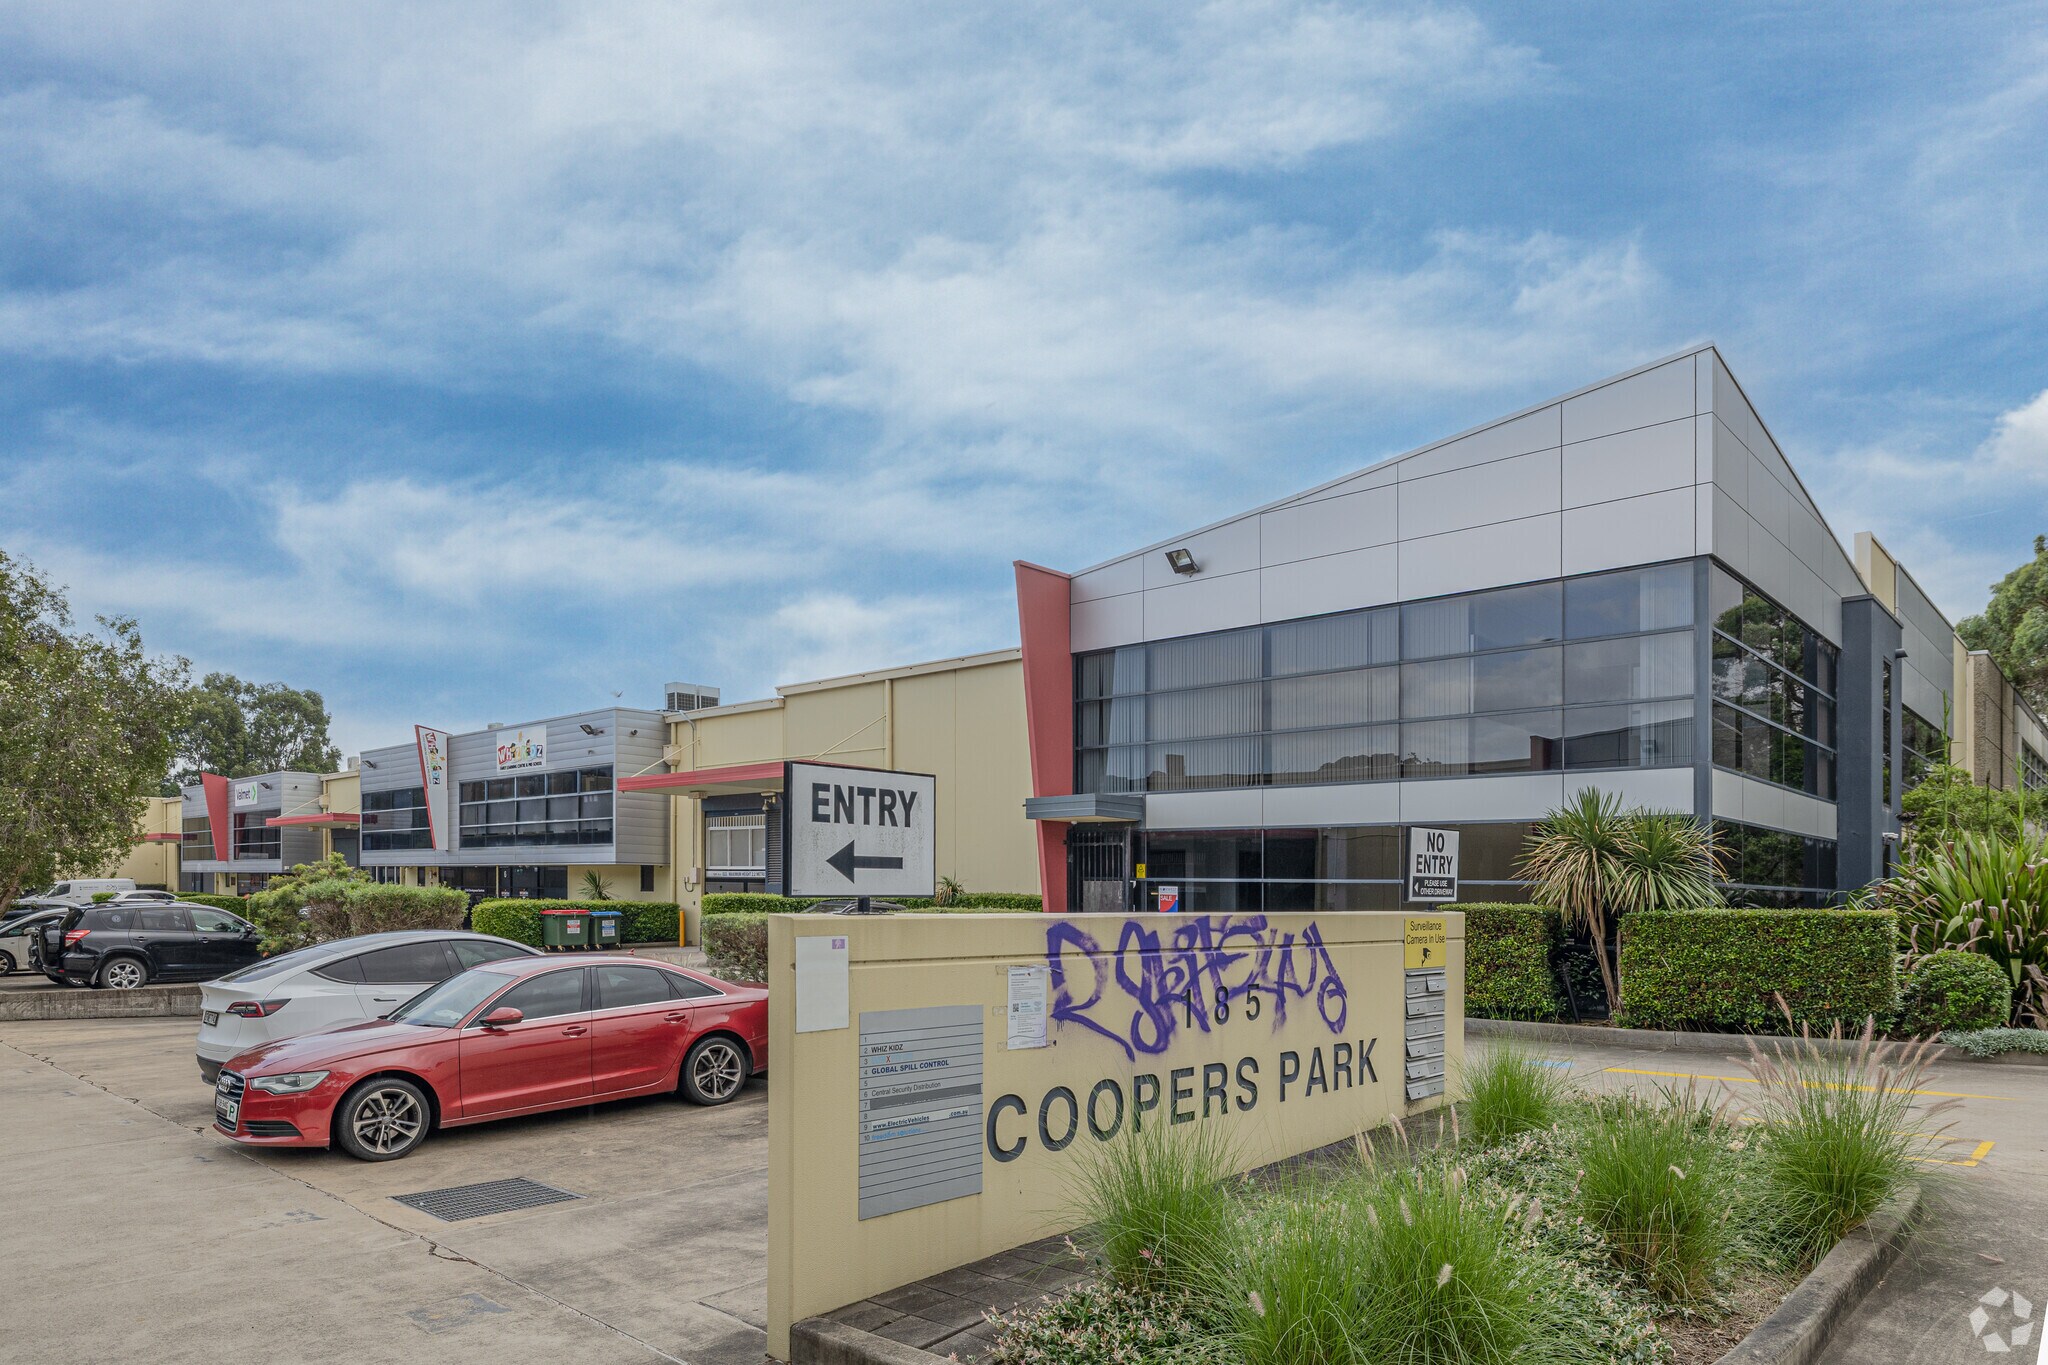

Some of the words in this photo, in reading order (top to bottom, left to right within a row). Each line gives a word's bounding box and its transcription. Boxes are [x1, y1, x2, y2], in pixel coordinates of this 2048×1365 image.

[812, 782, 918, 828] ENTRY
[1426, 831, 1445, 853] NO
[1416, 853, 1453, 875] ENTRY
[1424, 879, 1440, 887] PLEASE
[1440, 879, 1448, 887] USE
[1420, 887, 1434, 895] OTHER
[1434, 888, 1453, 896] DRIVEWAY
[1410, 920, 1442, 931] Surveillance
[1406, 935, 1428, 945] Camera
[1428, 934, 1434, 944] In
[1435, 934, 1445, 944] Use
[1181, 983, 1261, 1029] 185
[871, 1045, 888, 1053] WHIZ
[871, 1066, 898, 1075] GLOBAL
[900, 1064, 918, 1072] SPILL
[919, 1060, 949, 1069] CONTROL
[871, 1089, 891, 1097] Central
[891, 1085, 912, 1094] Security
[913, 1081, 941, 1091] Distribution
[986, 1056, 1259, 1162] COOPERS
[1279, 1037, 1378, 1102] PARK
[229, 1104, 235, 1118] P
